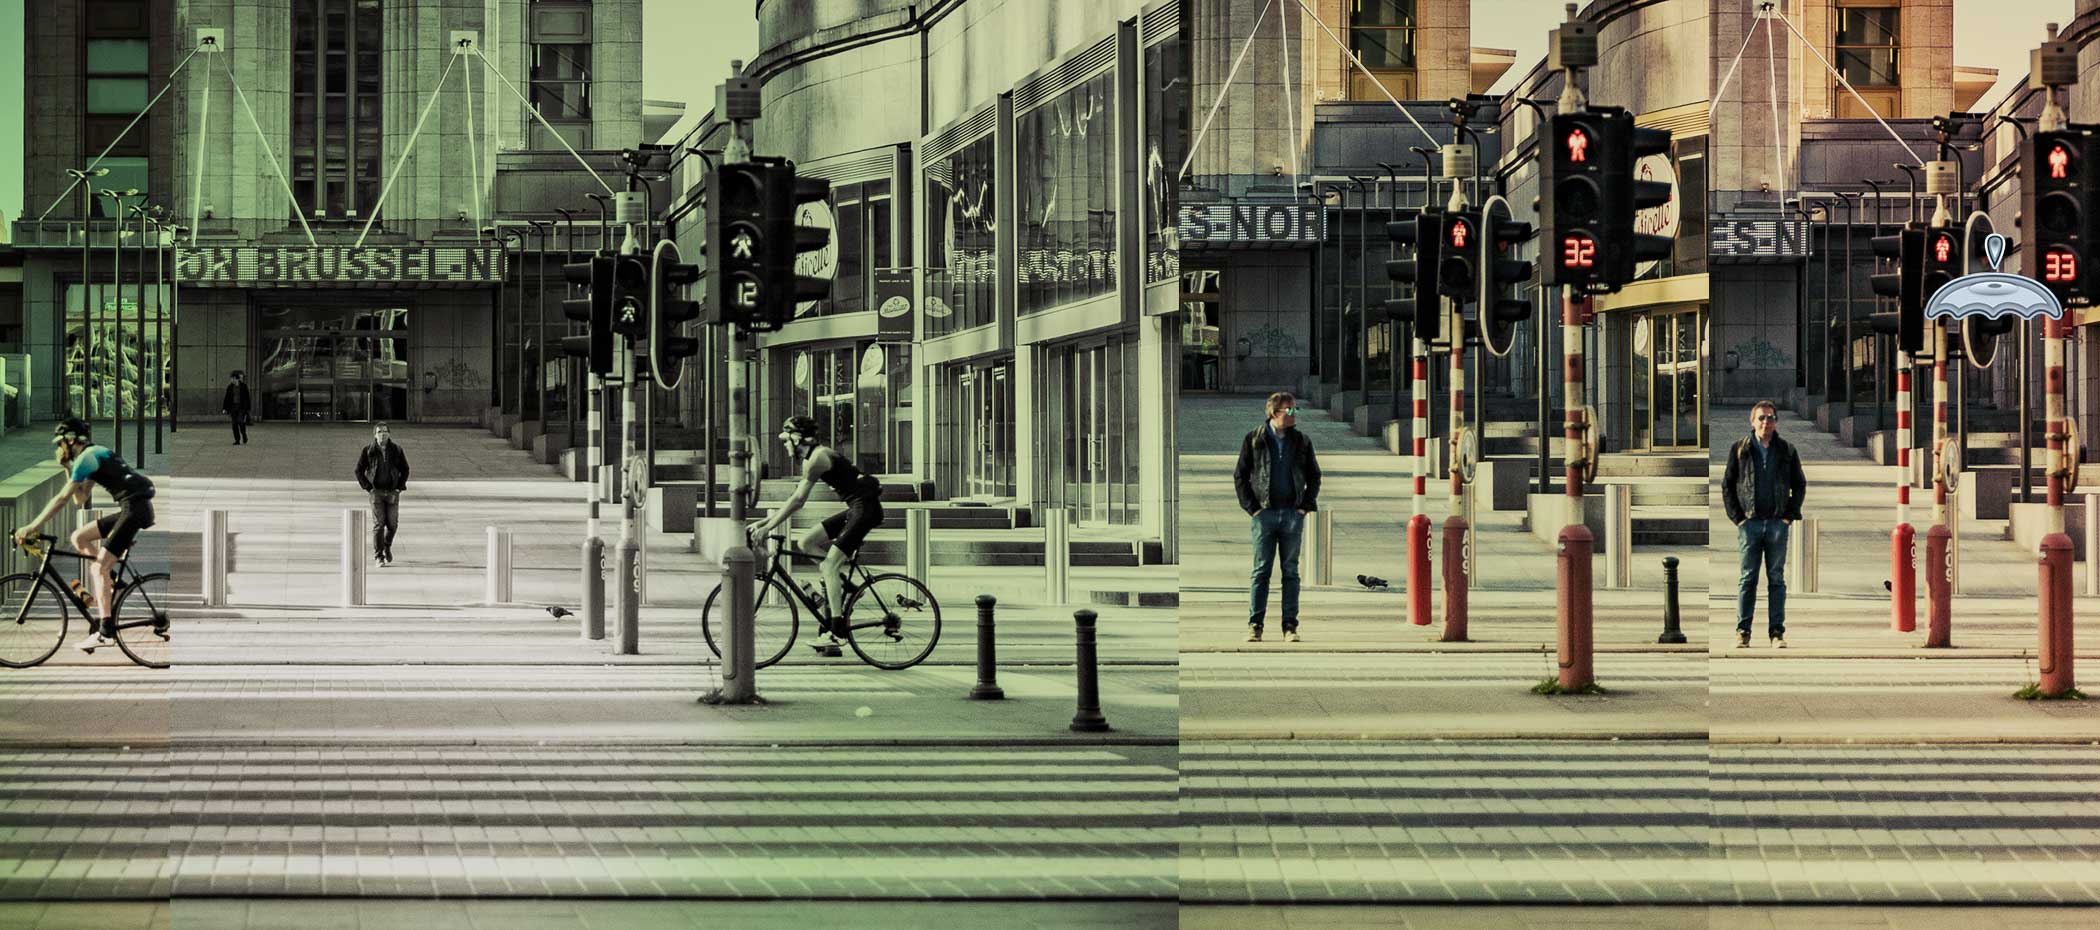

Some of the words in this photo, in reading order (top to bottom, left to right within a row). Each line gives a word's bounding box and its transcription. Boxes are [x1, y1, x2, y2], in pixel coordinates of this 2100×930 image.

[1565, 239, 1595, 266] 32
[2045, 253, 2075, 279] 33
[737, 281, 757, 306] 12
